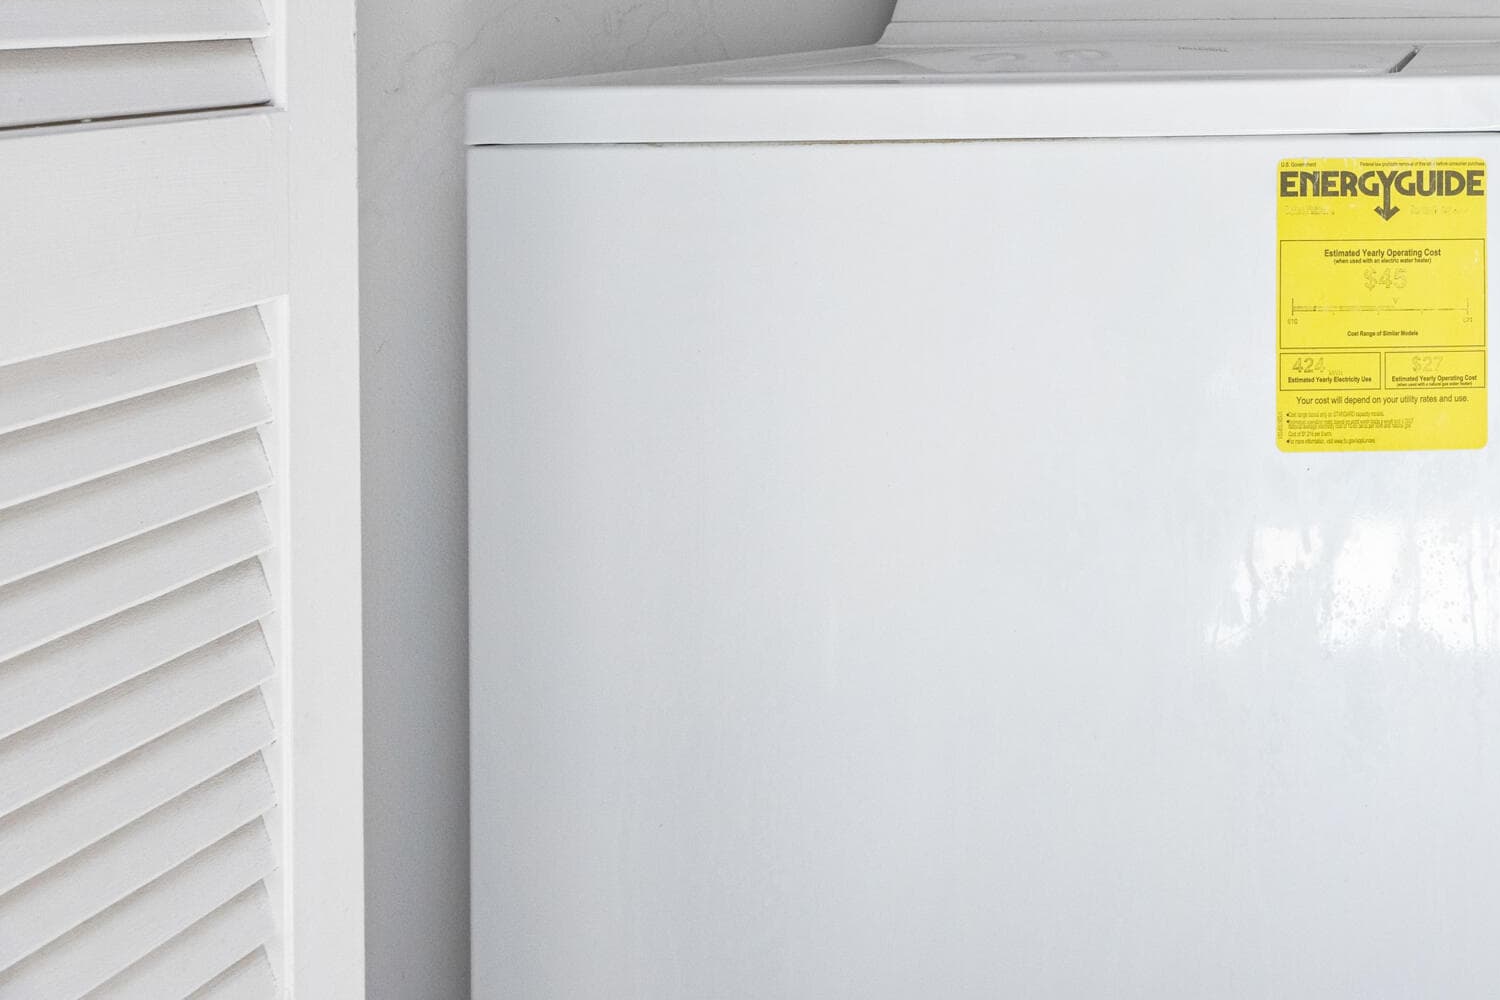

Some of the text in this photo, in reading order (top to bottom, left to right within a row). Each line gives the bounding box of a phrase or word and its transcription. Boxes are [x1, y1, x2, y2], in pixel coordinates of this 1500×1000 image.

[1280, 170, 1485, 198] ENERGYGUIDE
[1324, 248, 1441, 259] Estimated Yearly Operating Cost
[1364, 267, 1408, 291] $45
[1359, 330, 1376, 338] Range
[1292, 356, 1326, 374] 424
[1411, 355, 1444, 373] $27
[1316, 376, 1332, 385] Yearly
[1333, 376, 1360, 384] Electricity
[1419, 375, 1437, 383] Yearly
[1437, 374, 1464, 383] Operating
[1296, 396, 1313, 404] Your
[1344, 395, 1370, 405] depend
[1383, 397, 1398, 405] your
[1399, 395, 1418, 405] utility
[1439, 394, 1452, 402] and
